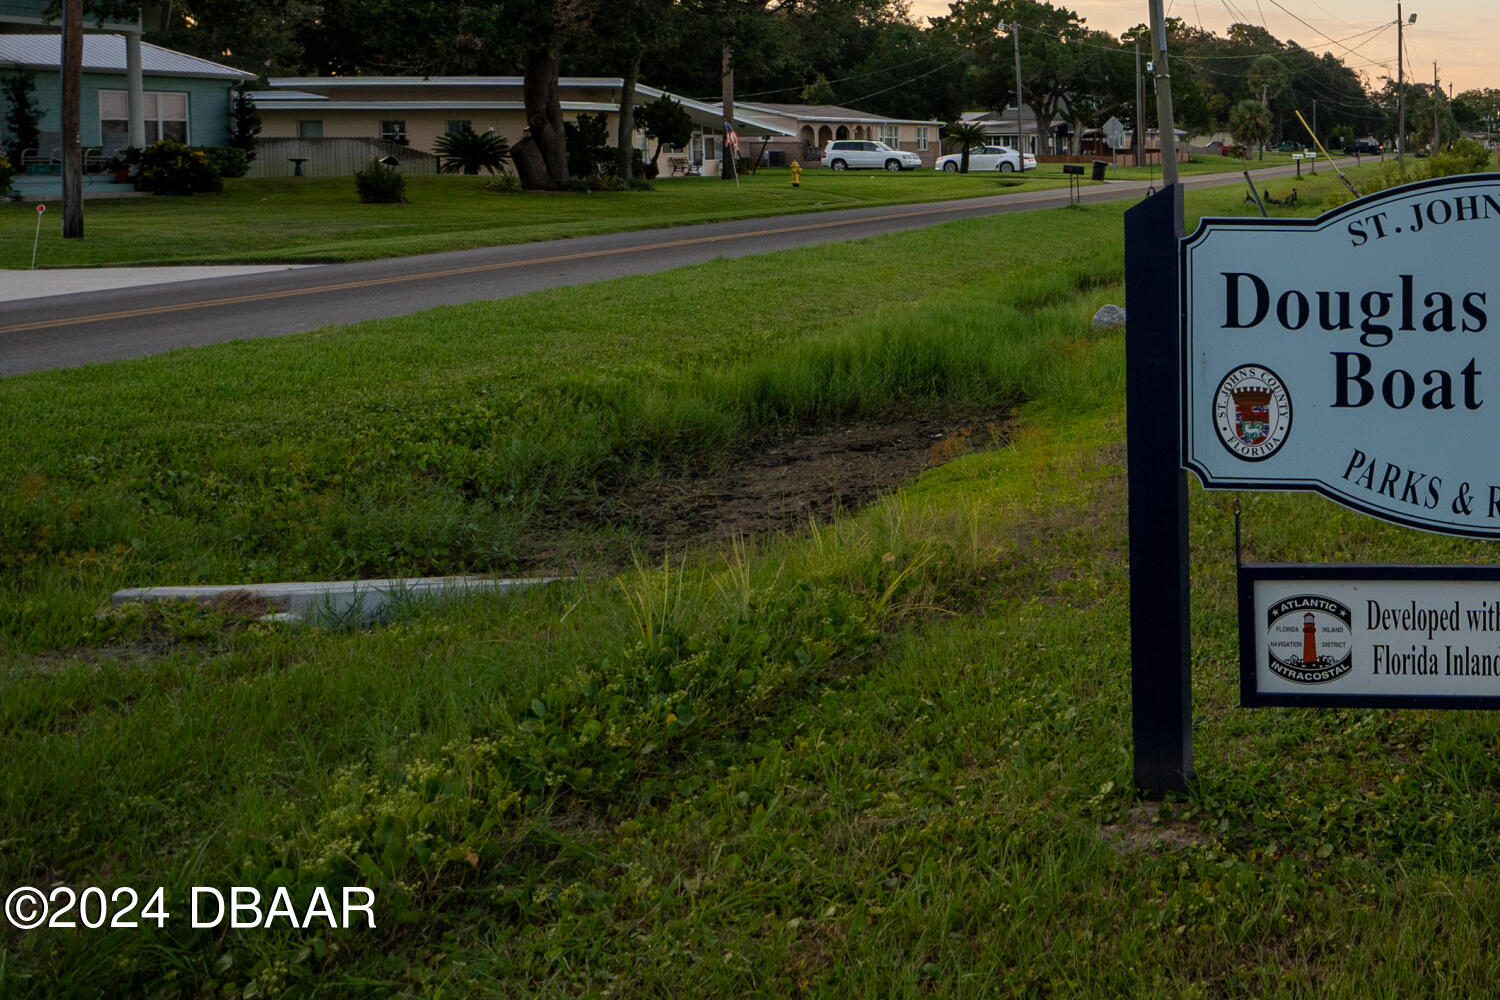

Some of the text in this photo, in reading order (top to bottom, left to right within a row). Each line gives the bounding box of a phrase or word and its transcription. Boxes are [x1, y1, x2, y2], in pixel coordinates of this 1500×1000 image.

[1348, 212, 1402, 248] ST.
[1220, 272, 1487, 347] Douglas
[1217, 368, 1289, 419] ST. JOHNS COUNTY
[1330, 352, 1484, 410] Boat
[1227, 437, 1280, 456] FLORIDA
[1341, 448, 1443, 510] PARKS
[1452, 481, 1474, 516] &
[1280, 598, 1338, 612] ATLANTIC
[1366, 599, 1460, 640] Developed
[1270, 660, 1350, 681] INTRACOSTAL
[1372, 644, 1439, 677] Florida
